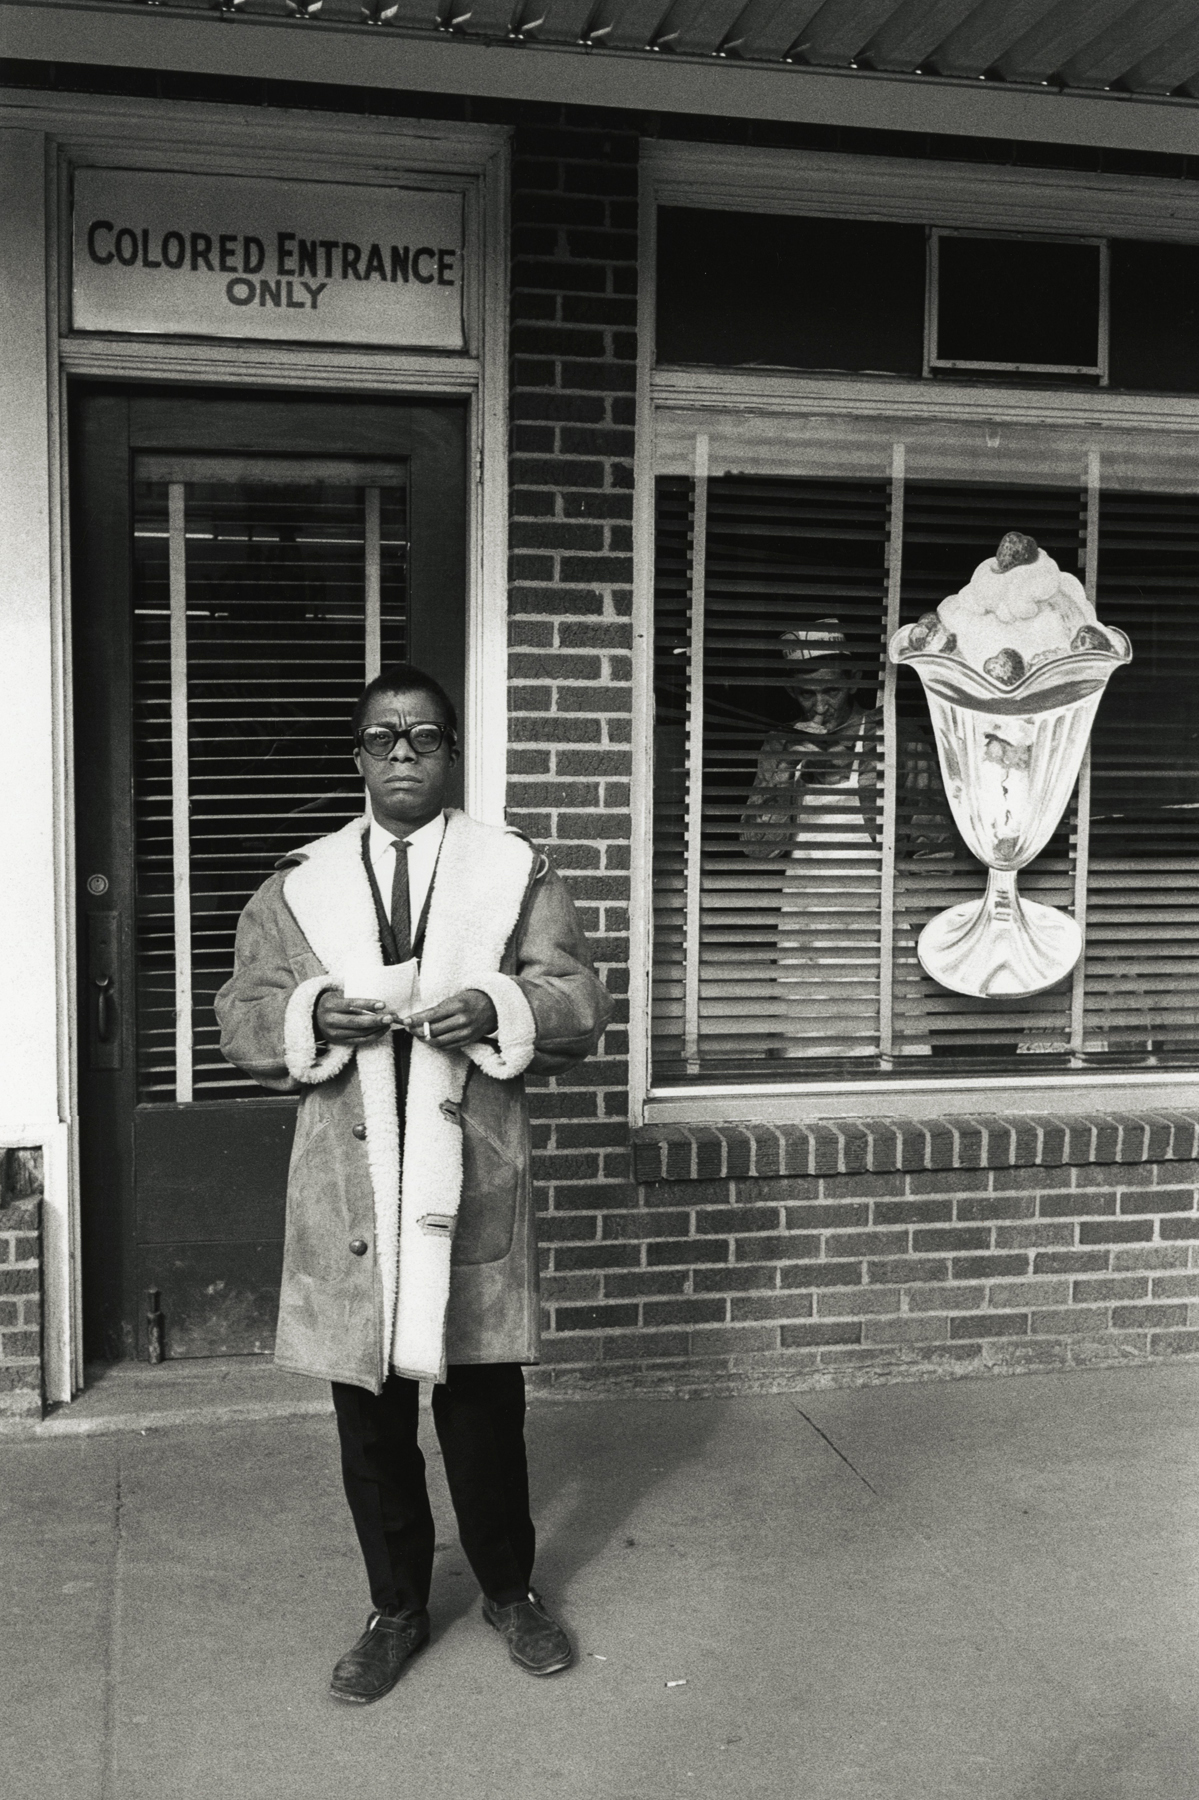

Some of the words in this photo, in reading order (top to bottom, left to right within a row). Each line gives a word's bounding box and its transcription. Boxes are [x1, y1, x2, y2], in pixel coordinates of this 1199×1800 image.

[88, 220, 265, 274] COLORED
[277, 232, 456, 286] ENTRANCE
[226, 277, 328, 309] ONLY
